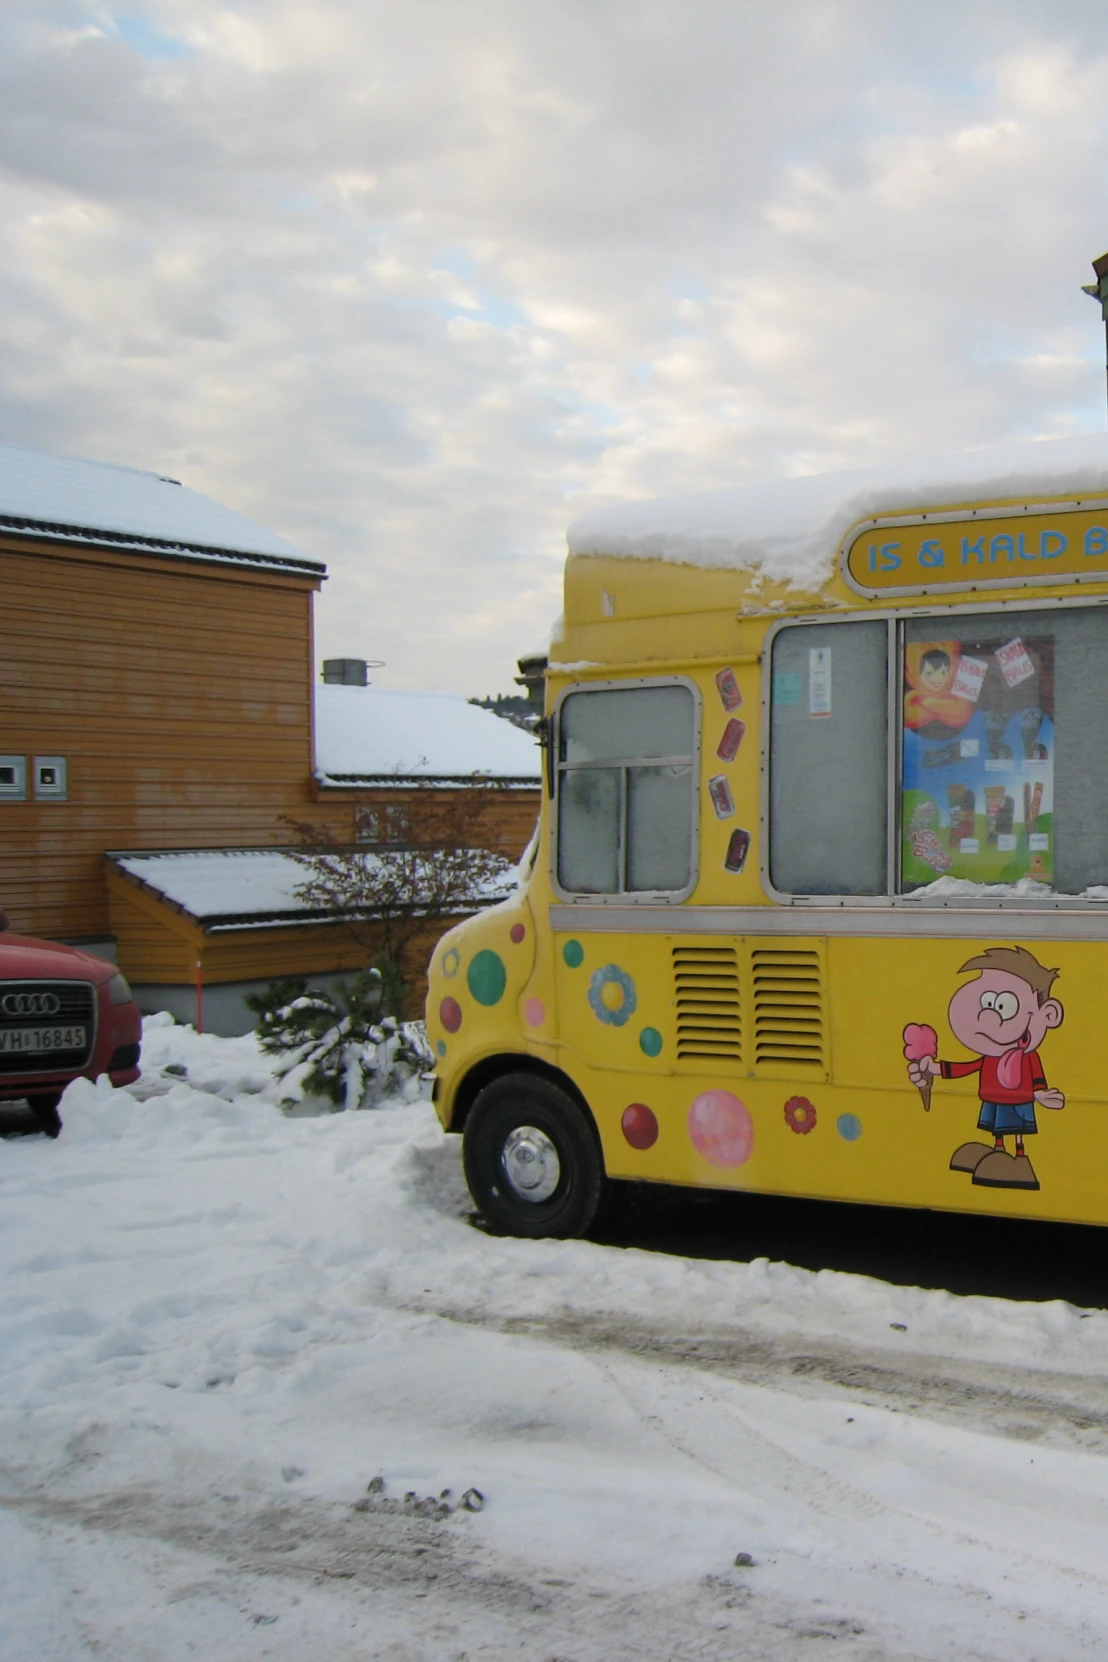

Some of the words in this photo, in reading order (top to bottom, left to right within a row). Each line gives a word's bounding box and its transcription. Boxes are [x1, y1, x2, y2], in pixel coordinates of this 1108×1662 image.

[868, 543, 902, 572] IS
[917, 540, 946, 568] &
[960, 530, 1068, 566] KALD
[34, 1029, 82, 1048] 16845
